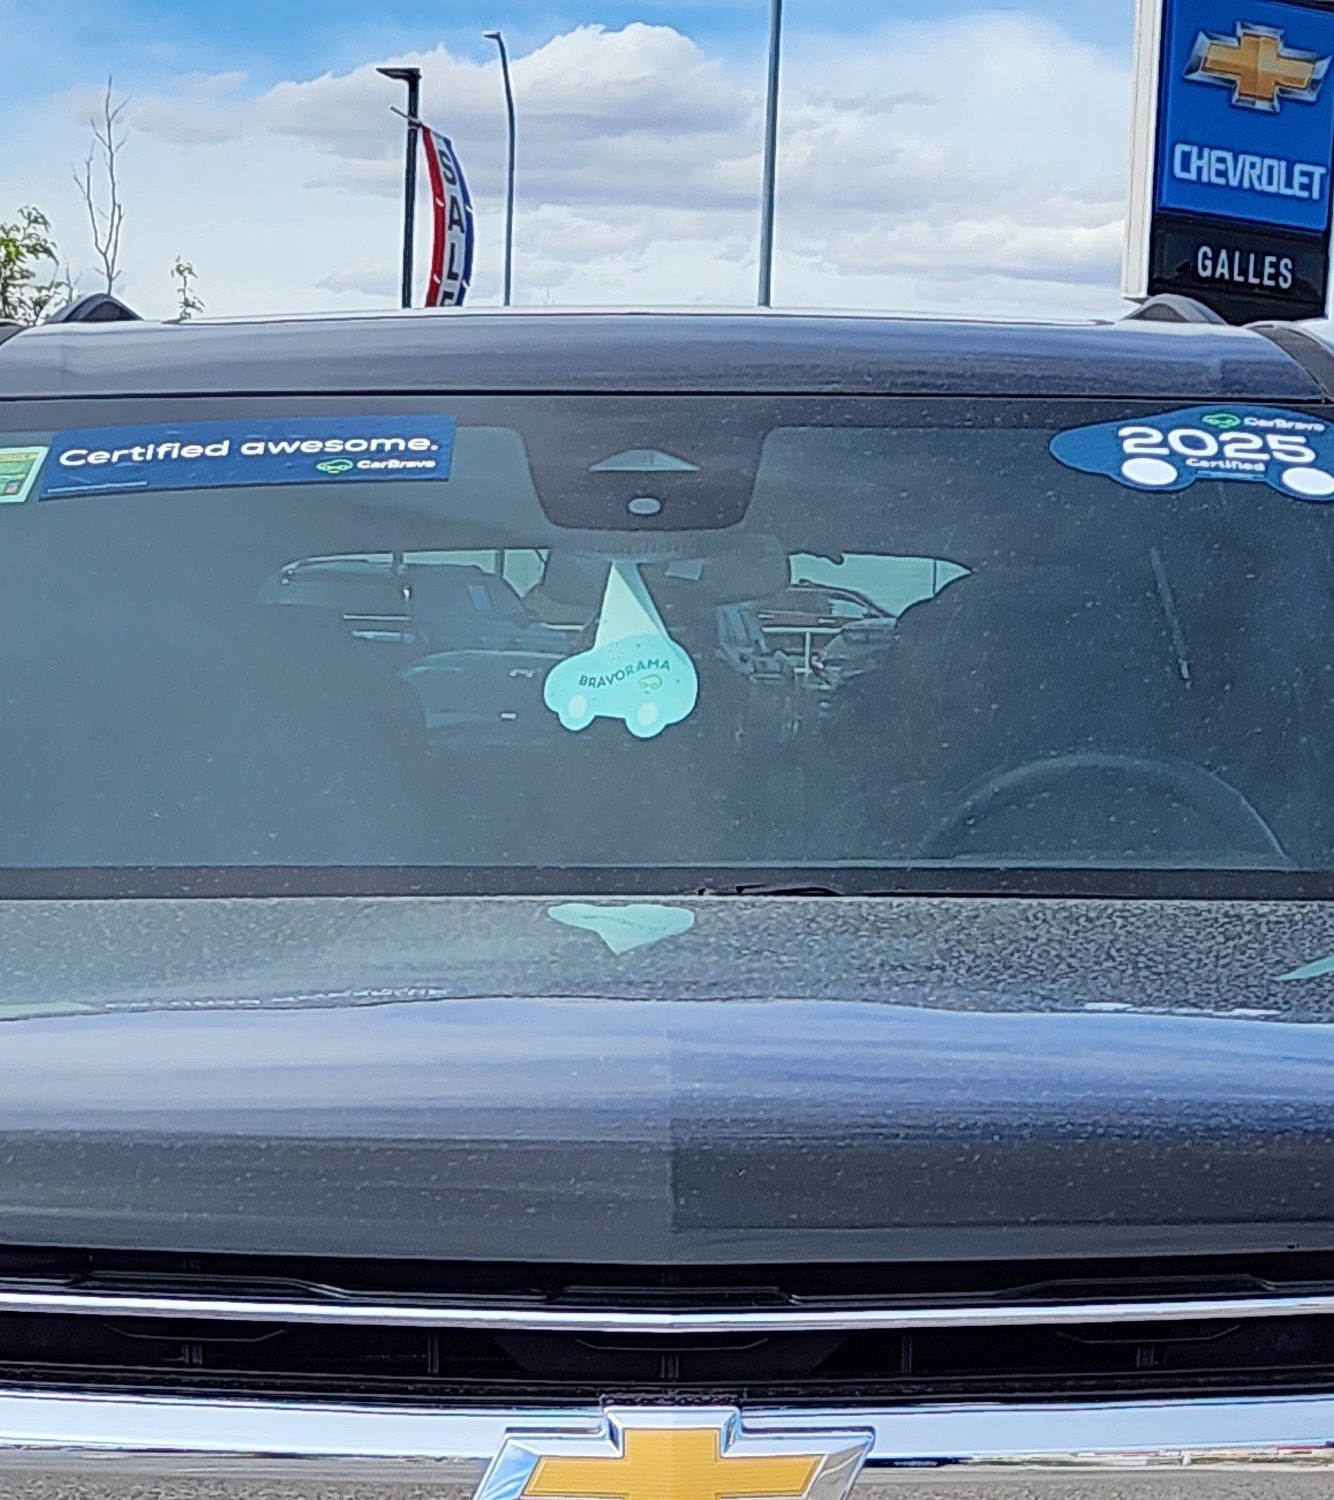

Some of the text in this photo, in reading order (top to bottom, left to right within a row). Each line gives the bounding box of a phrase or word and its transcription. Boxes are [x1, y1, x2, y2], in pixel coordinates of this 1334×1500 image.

[1173, 142, 1326, 200] CHEVROLET
[1197, 245, 1293, 289] GALLES
[59, 439, 230, 467] Certified
[240, 437, 439, 456] awesome.
[1118, 426, 1317, 464] 2025
[579, 659, 670, 688] BRAVORAMA
